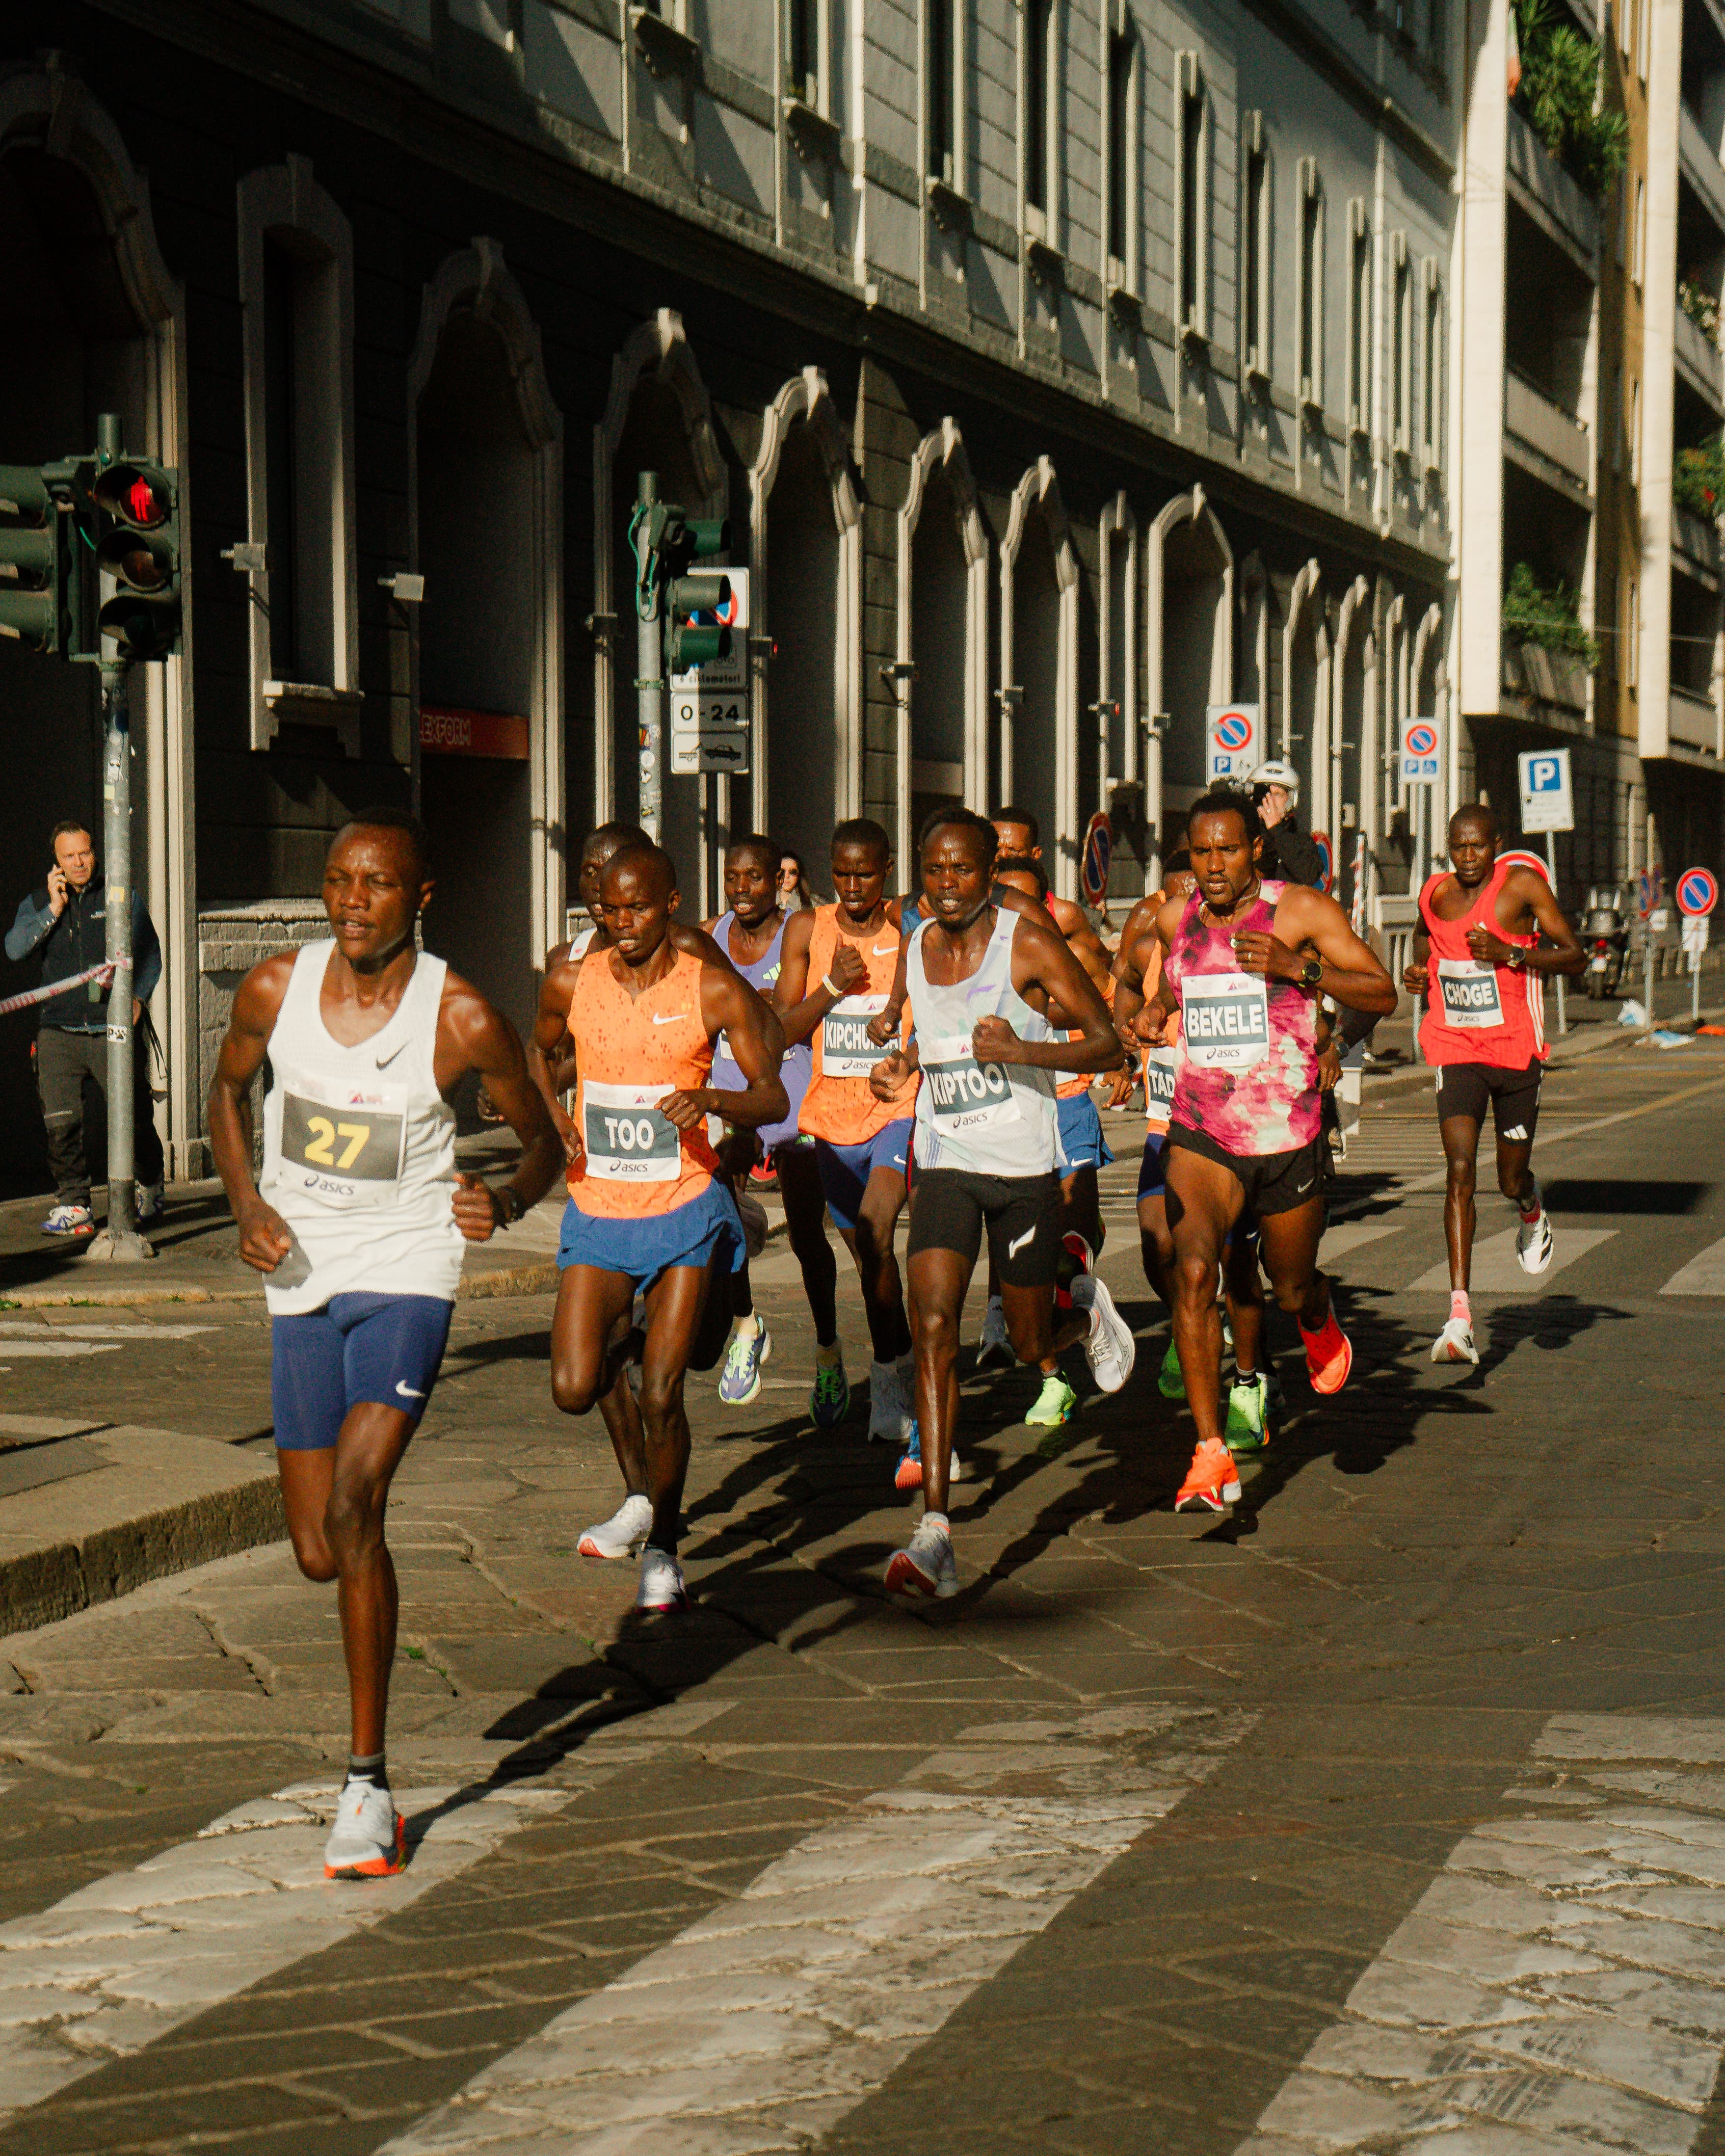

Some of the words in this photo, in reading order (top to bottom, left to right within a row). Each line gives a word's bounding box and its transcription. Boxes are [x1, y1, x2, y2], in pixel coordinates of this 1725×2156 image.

[711, 704, 739, 720] 24
[1217, 758, 1229, 773] P
[1533, 761, 1556, 791] P
[1445, 981, 1494, 1007] CHOGE
[1188, 1003, 1264, 1037] BEKELE
[826, 1021, 898, 1050] KIPCHU
[929, 1063, 1004, 1105] KIPTOO
[304, 1116, 370, 1169] 27
[604, 1116, 654, 1151] TOO
